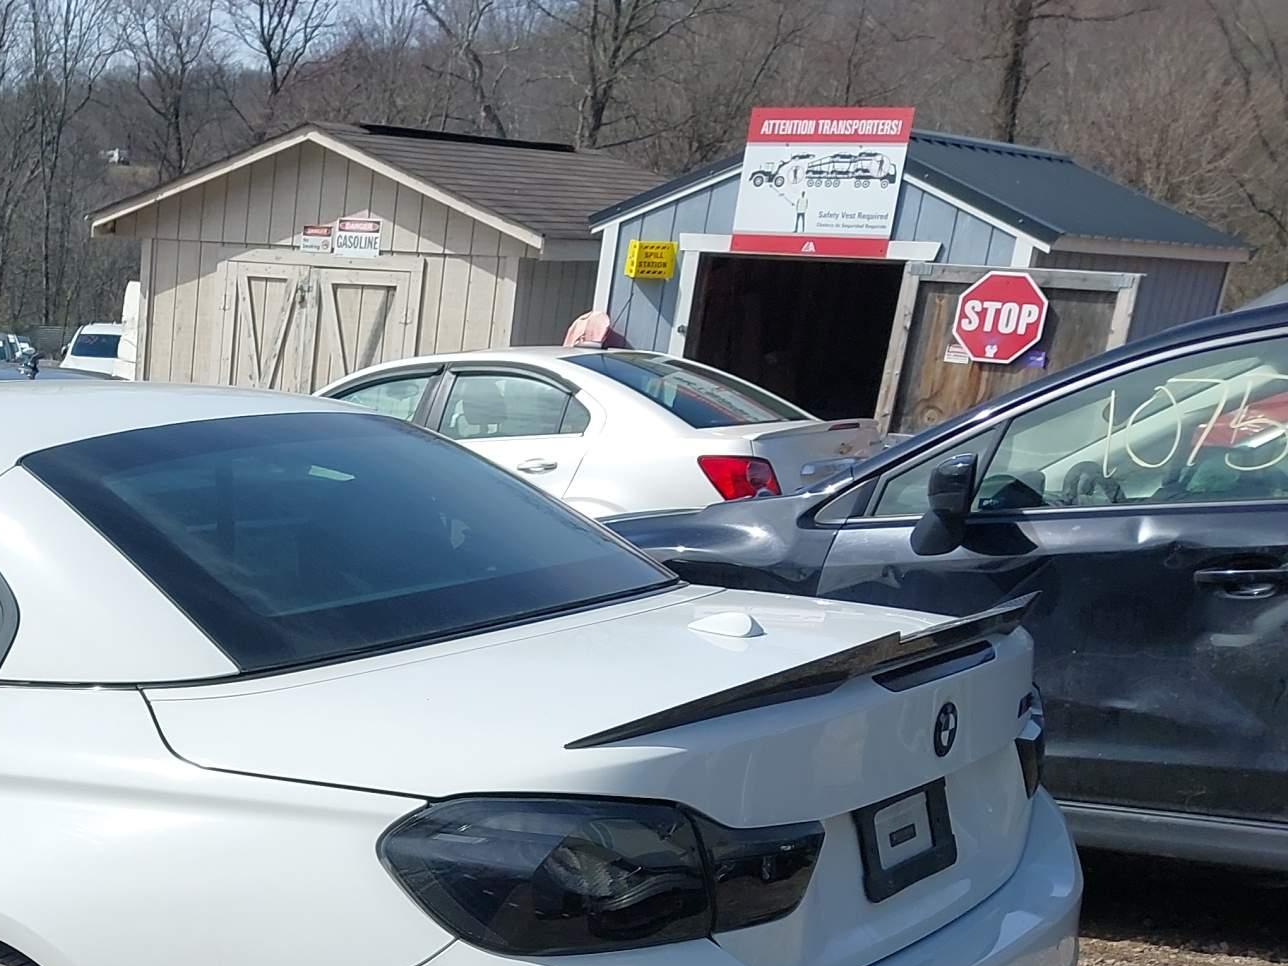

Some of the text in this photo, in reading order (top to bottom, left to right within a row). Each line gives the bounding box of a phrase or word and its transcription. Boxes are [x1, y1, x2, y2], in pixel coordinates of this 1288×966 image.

[760, 119, 902, 135] ATTENTION TRANSPORTERS!
[818, 210, 889, 221] Safety Vest Required
[336, 234, 379, 250] GASOLINE
[638, 261, 667, 269] STATION
[960, 299, 1040, 336] STOP
